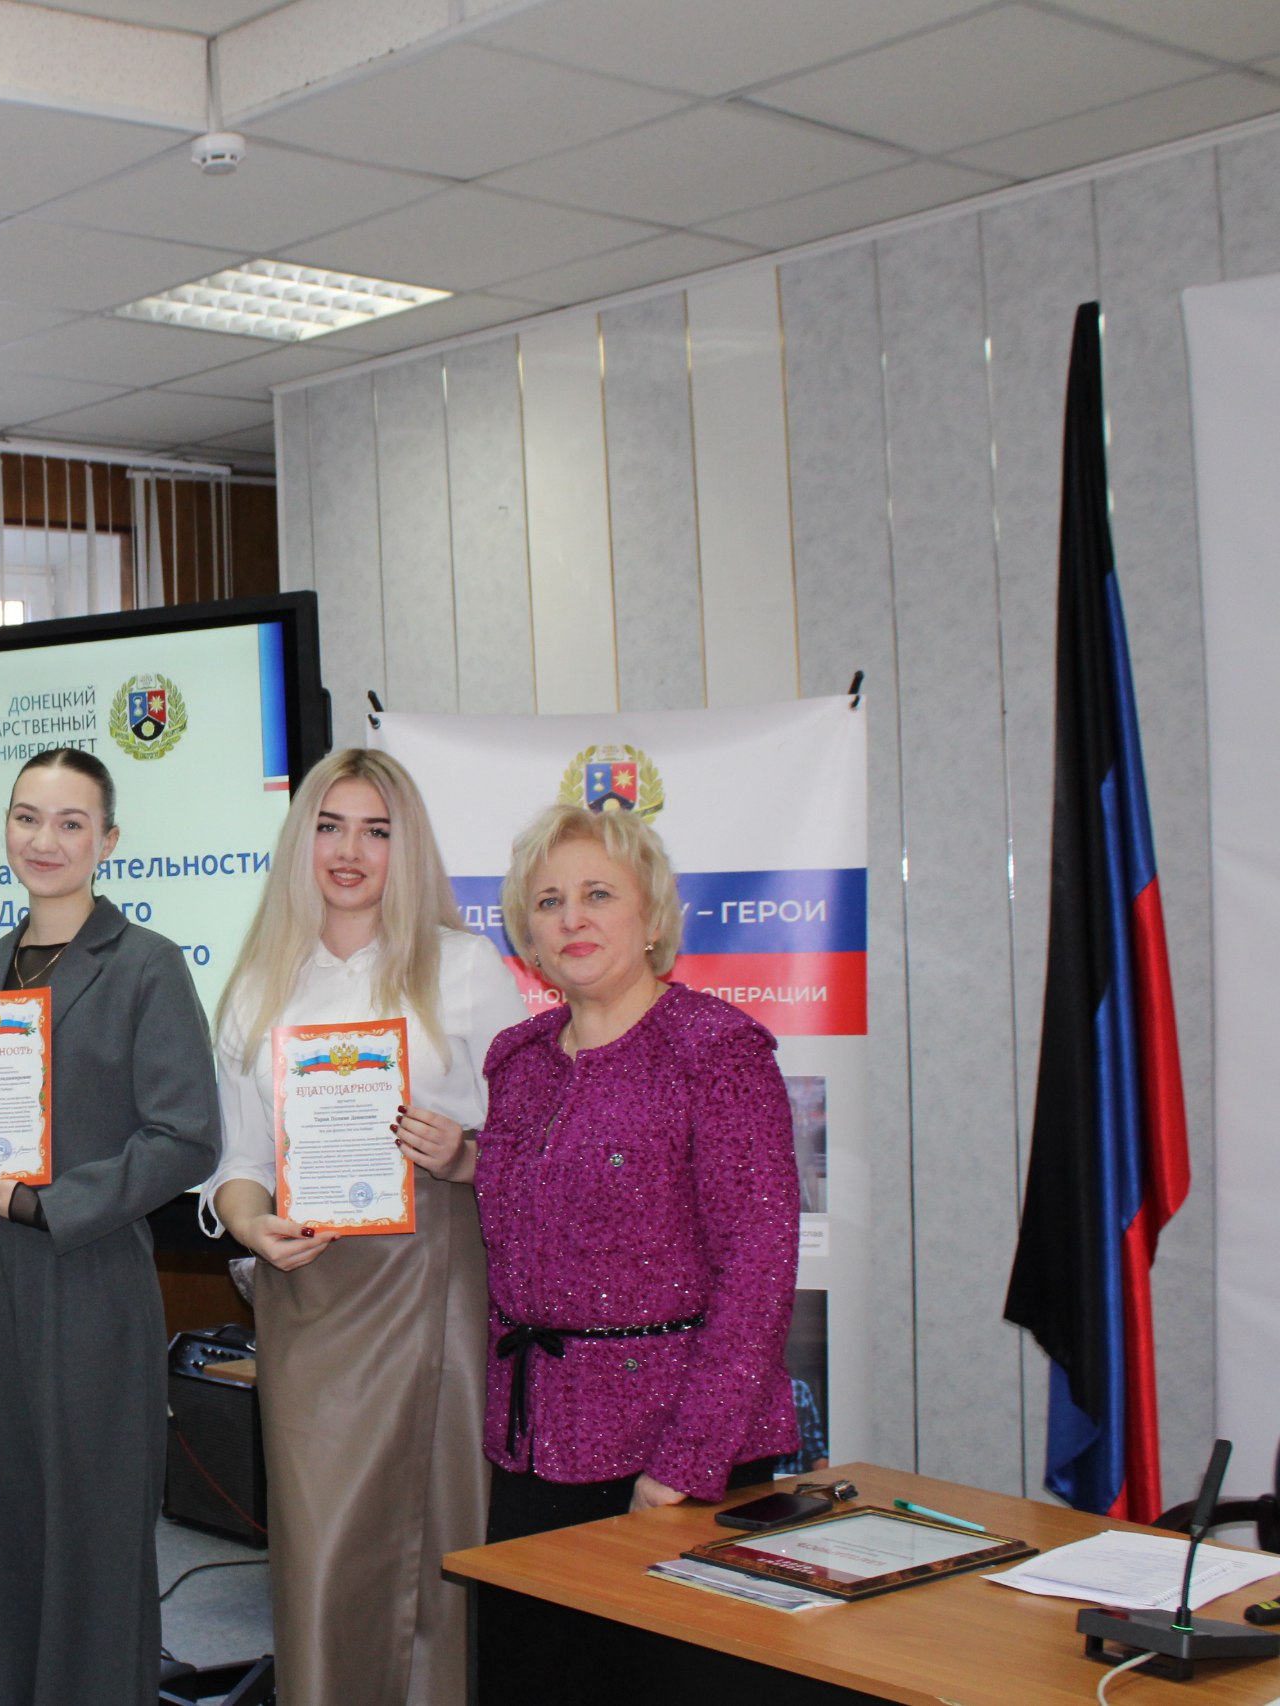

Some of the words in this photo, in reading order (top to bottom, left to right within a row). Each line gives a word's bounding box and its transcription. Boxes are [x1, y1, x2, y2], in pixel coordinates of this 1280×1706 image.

[8, 686, 96, 716] ДОНЕЦКИЙ
[96, 852, 271, 881] ятельности
[721, 900, 826, 924] ГЕРОИ
[296, 1083, 392, 1097] БЛАГОДАРНОСТЬ
